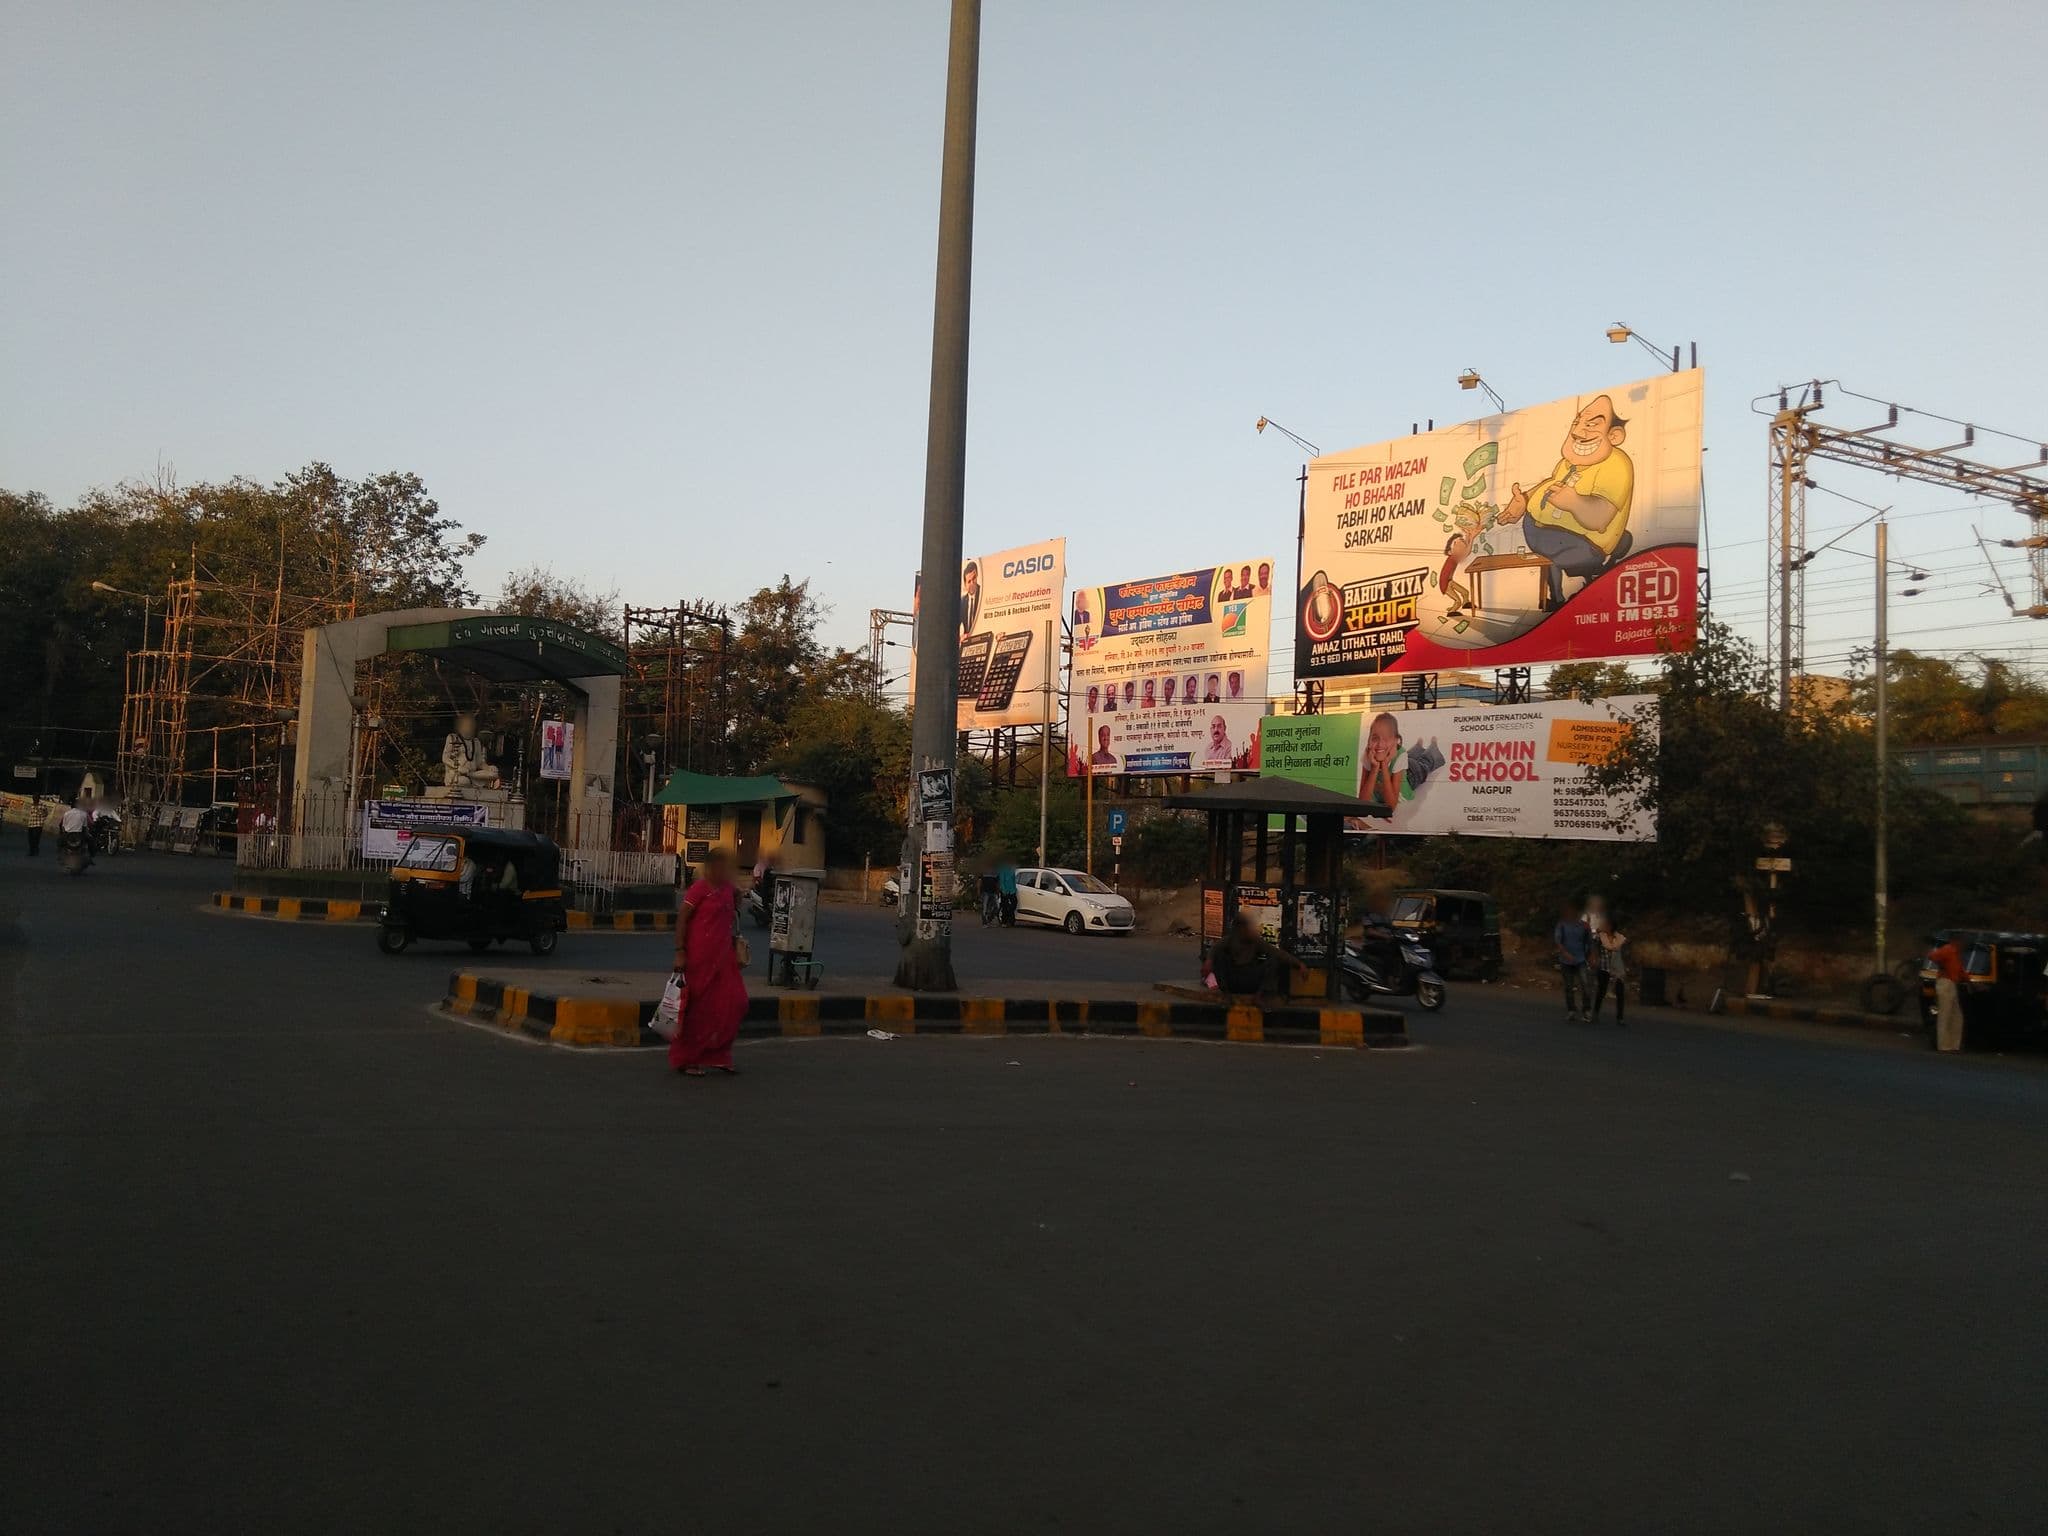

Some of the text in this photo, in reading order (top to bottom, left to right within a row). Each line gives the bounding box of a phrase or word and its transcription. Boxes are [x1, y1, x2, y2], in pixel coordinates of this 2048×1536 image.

[1333, 456, 1428, 492] FILE PAR WAZAN
[1345, 482, 1405, 509] HO BHAARI
[1337, 498, 1426, 530] TABHI HO KAAM
[1344, 525, 1393, 548] SARKARI
[1004, 554, 1054, 578] CASIO
[1625, 561, 1658, 570] superhits
[1012, 587, 1051, 601] Reputation
[1344, 576, 1422, 608] BAHUT KIYA
[1618, 568, 1679, 608] RED
[994, 610, 1007, 618] Check
[1012, 606, 1030, 615] Recheck
[1031, 602, 1051, 612] Function
[1345, 597, 1417, 630] सम्मान
[1574, 612, 1609, 624] TUNE IN
[1618, 605, 1678, 622] FM 93.5
[1616, 627, 1652, 642] Bajaate
[1312, 640, 1340, 655] AWAAZ
[1342, 634, 1377, 650] UTHATE
[1310, 656, 1326, 666] 93.5
[1327, 654, 1340, 664] RED
[1342, 652, 1352, 661] FM
[1354, 647, 1386, 660] BAJAATE
[1483, 712, 1543, 721] INTERNATIONAL
[1266, 723, 1320, 740] आपल्या मुलांना
[1460, 722, 1534, 732] SCHOOLS PRESENTS
[1570, 725, 1617, 734] ADMISSIONS
[1300, 739, 1323, 752] शाळेत
[1451, 740, 1535, 761] RUKMIN
[1265, 756, 1282, 768] प्रवेश
[1314, 754, 1331, 768] नाही
[1449, 761, 1539, 782] SCHOOL
[1472, 786, 1512, 794] NAGPUR
[1554, 799, 1607, 807] 9325417303,
[1113, 814, 1123, 829] P
[1554, 820, 1606, 828] 937069619
